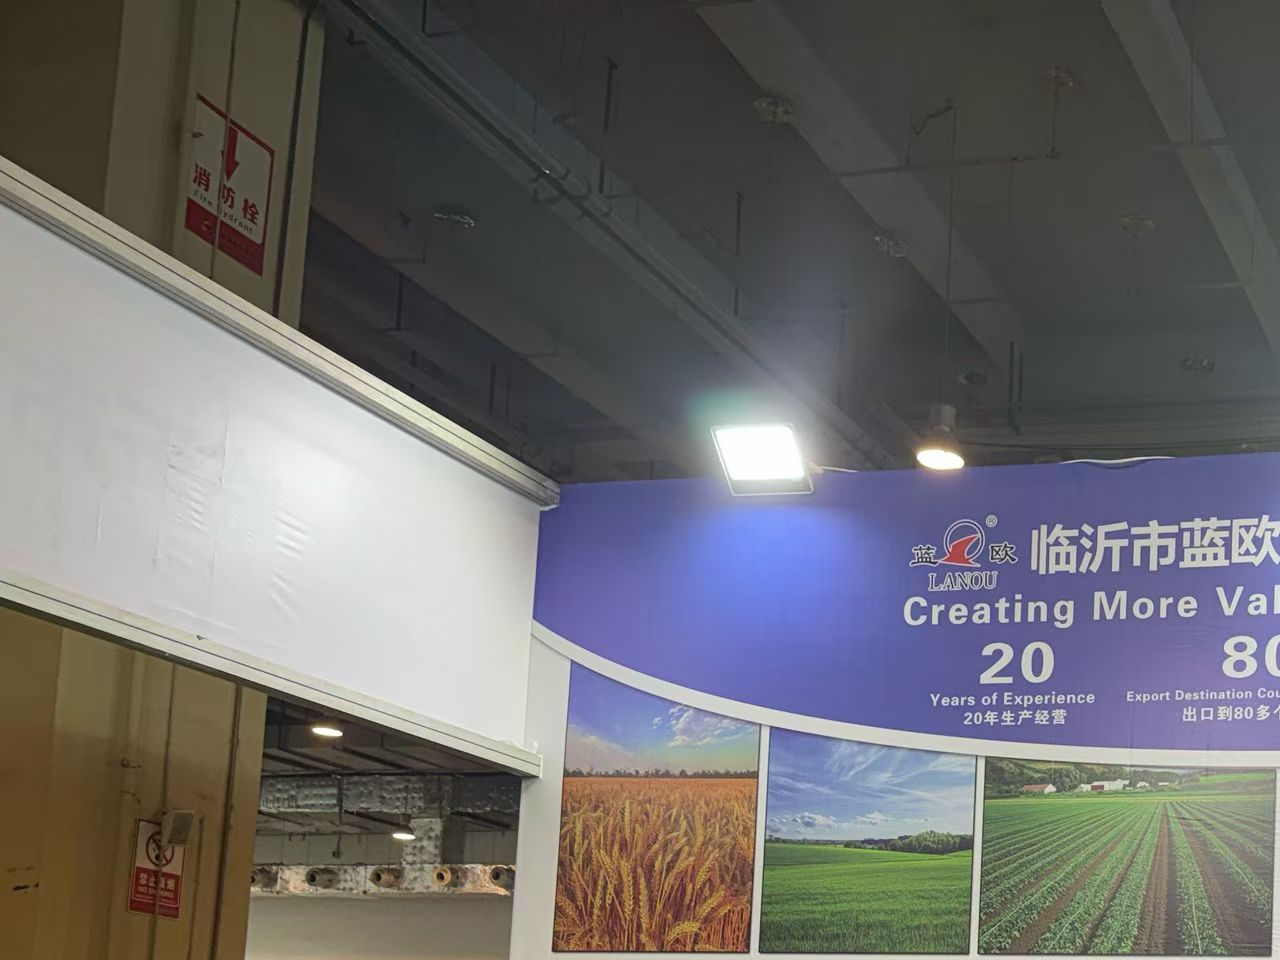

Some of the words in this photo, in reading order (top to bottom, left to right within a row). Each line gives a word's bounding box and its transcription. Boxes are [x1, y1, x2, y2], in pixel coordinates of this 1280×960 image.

[193, 163, 259, 226] 消防栓
[909, 545, 938, 567] 蓝
[989, 543, 1018, 564] 欧
[928, 571, 998, 592] LANOU
[903, 594, 1075, 629] Creating
[1092, 590, 1198, 621] More
[979, 641, 1055, 685] 20
[930, 693, 975, 706] Years
[981, 692, 998, 706] of
[1003, 691, 1095, 707] Experience
[1126, 690, 1170, 704] Export
[1175, 689, 1252, 701] Destination
[963, 709, 1067, 726] 20年生产经营
